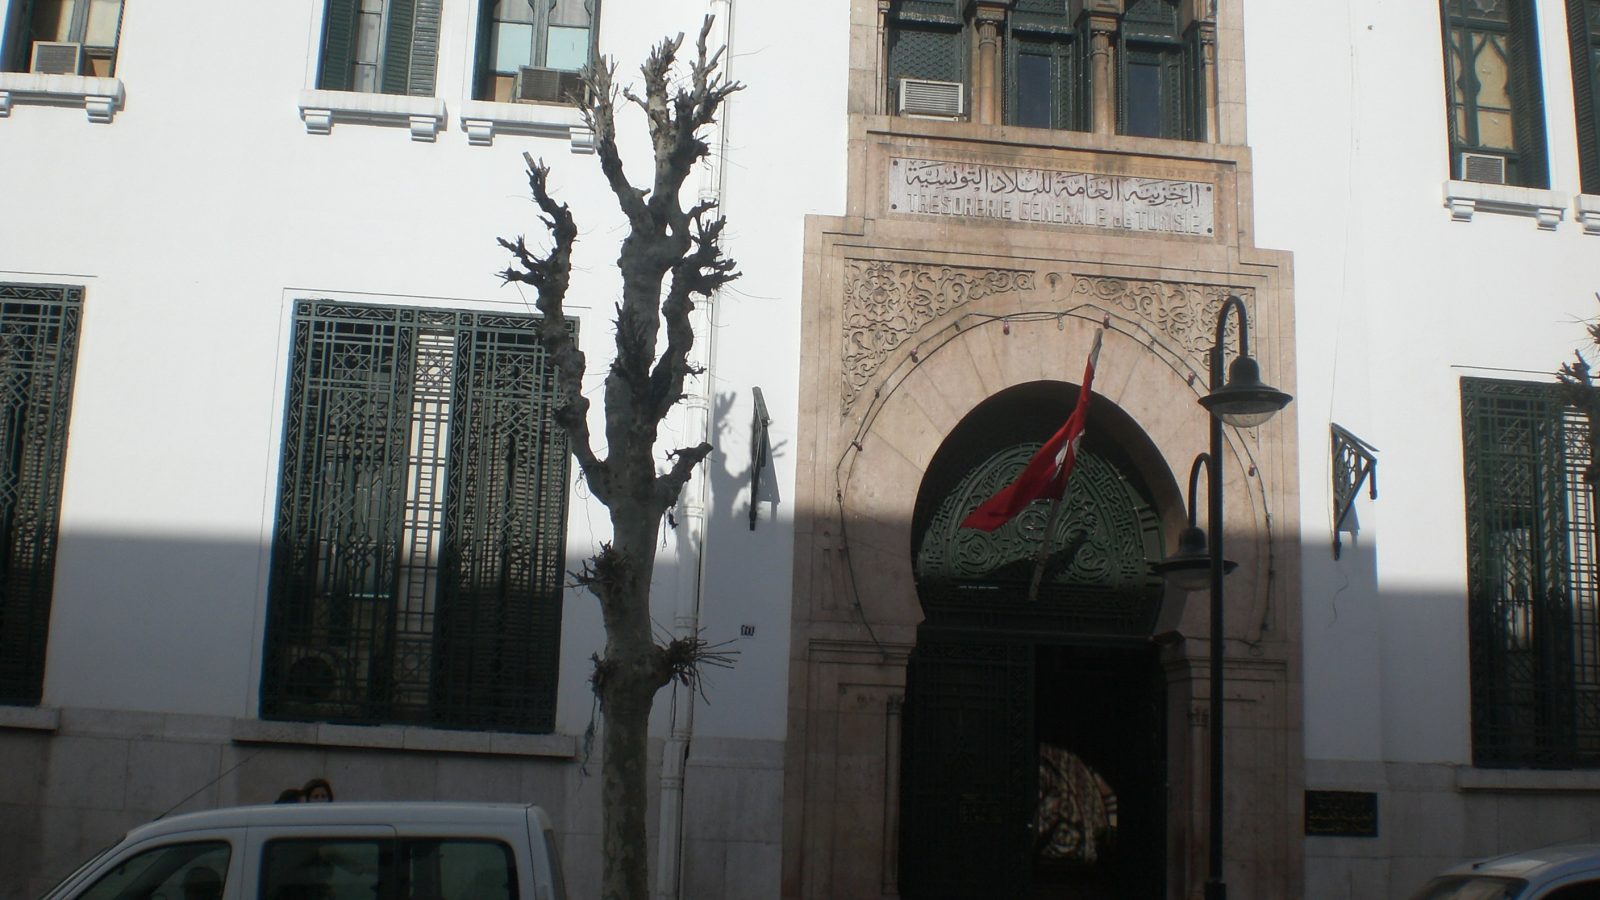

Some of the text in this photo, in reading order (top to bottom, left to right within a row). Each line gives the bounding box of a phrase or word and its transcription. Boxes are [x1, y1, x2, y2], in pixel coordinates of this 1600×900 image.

[907, 192, 1012, 220] TRESORERIE
[1018, 200, 1106, 227] GENERALE
[1135, 210, 1200, 234] TUNISIE
